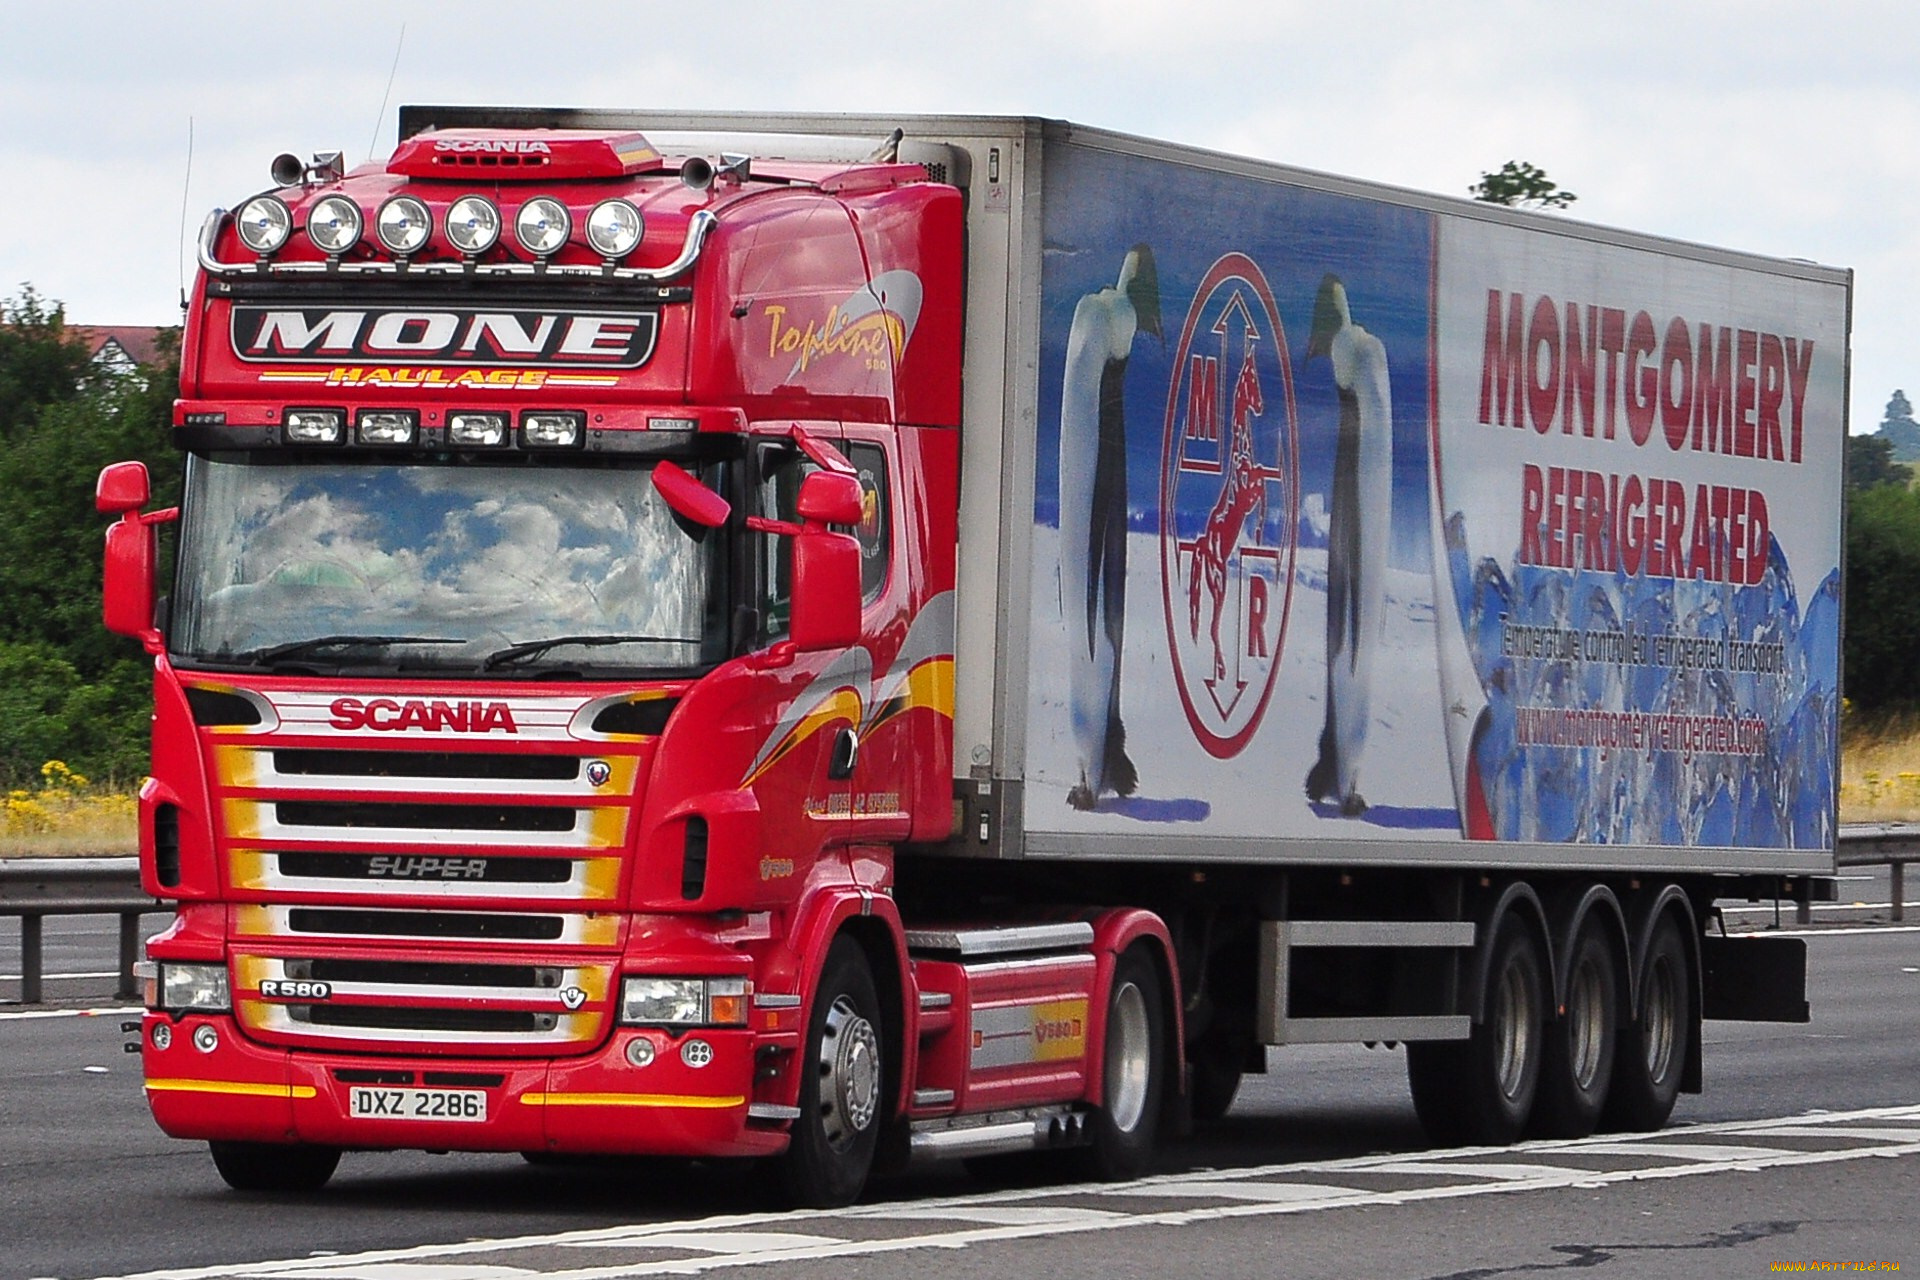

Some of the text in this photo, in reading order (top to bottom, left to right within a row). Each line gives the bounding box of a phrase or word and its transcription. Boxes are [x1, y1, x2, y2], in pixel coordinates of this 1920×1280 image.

[434, 139, 550, 154] SCANIA
[247, 310, 641, 359] MONE
[764, 304, 886, 372] Topline
[327, 367, 548, 389] HAULAGE
[865, 358, 887, 371] 580
[1478, 288, 1815, 464] MONTGOMERY
[1519, 463, 1770, 587] REFRIGERATED
[1584, 619, 1648, 666] controlled
[1651, 622, 1725, 681] refrigerated
[1729, 634, 1785, 685] transport
[329, 697, 518, 734] SCANIA
[1516, 699, 1766, 764] www.montgomeryrefrigerated.com
[367, 856, 487, 878] SUPER
[261, 981, 328, 998] R 580
[358, 1090, 479, 1117] DXZ 2286
